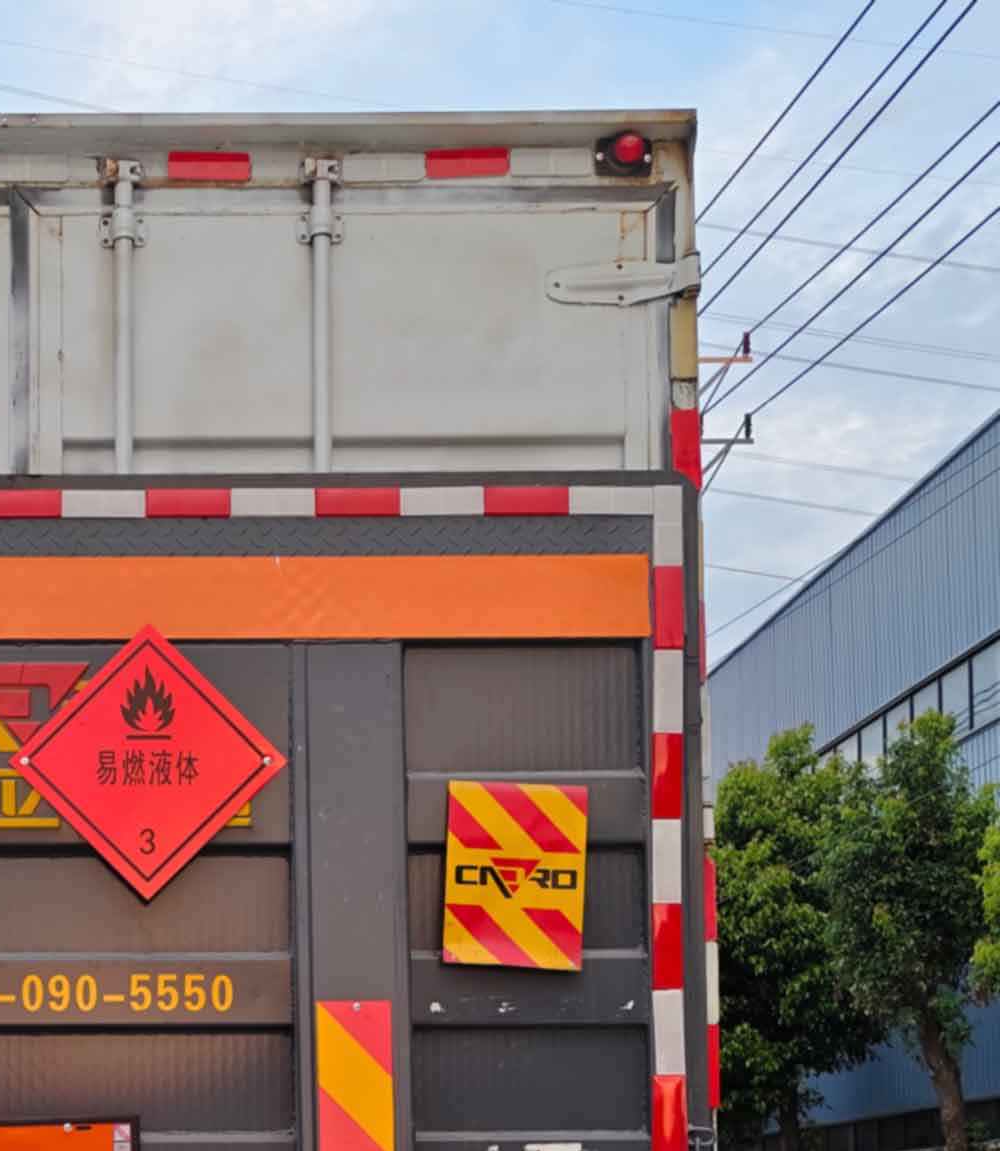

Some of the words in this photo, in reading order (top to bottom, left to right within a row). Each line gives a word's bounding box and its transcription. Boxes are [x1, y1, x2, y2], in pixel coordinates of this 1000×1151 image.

[96, 749, 199, 786] 易燃液体
[139, 828, 156, 855] 3
